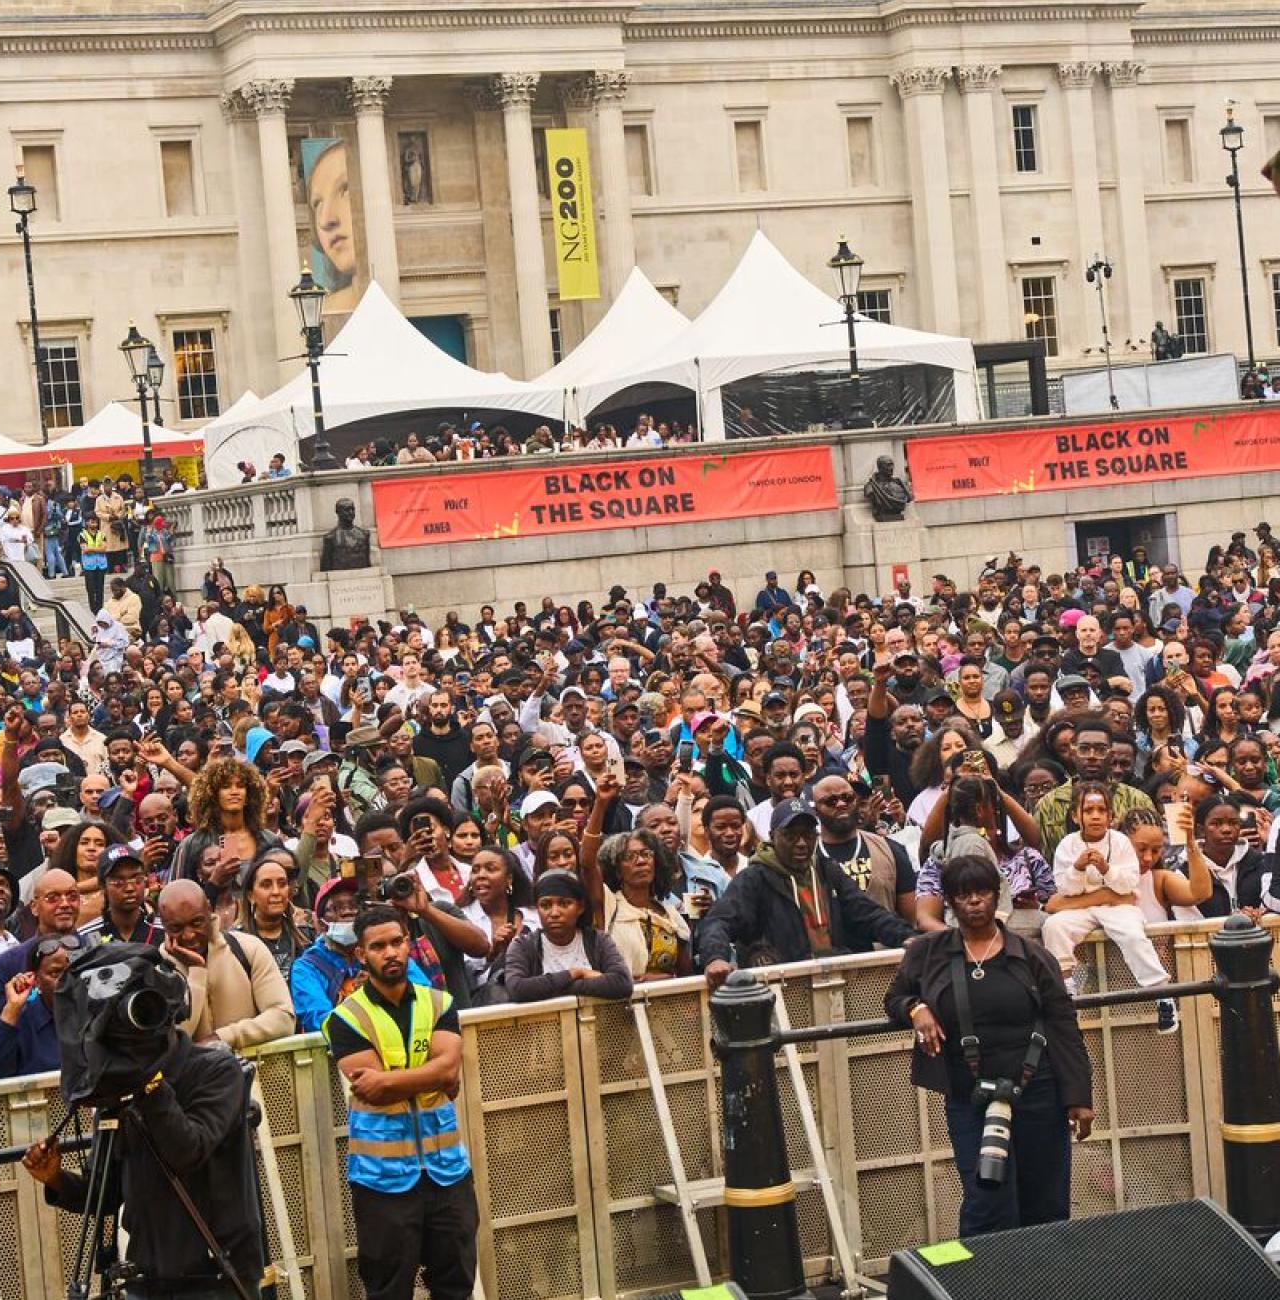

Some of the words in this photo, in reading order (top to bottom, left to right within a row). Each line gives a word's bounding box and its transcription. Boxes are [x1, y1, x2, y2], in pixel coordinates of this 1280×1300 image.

[555, 157, 582, 262] NG200
[1055, 429, 1132, 454] BLACK
[1137, 426, 1170, 446] ON
[544, 470, 632, 495] BLACK
[638, 466, 675, 488] ON
[788, 475, 822, 484] LONDON
[1044, 459, 1090, 481] THE
[1095, 451, 1188, 477] SQUARE
[531, 502, 583, 524] THE
[588, 493, 695, 520] SQUARE
